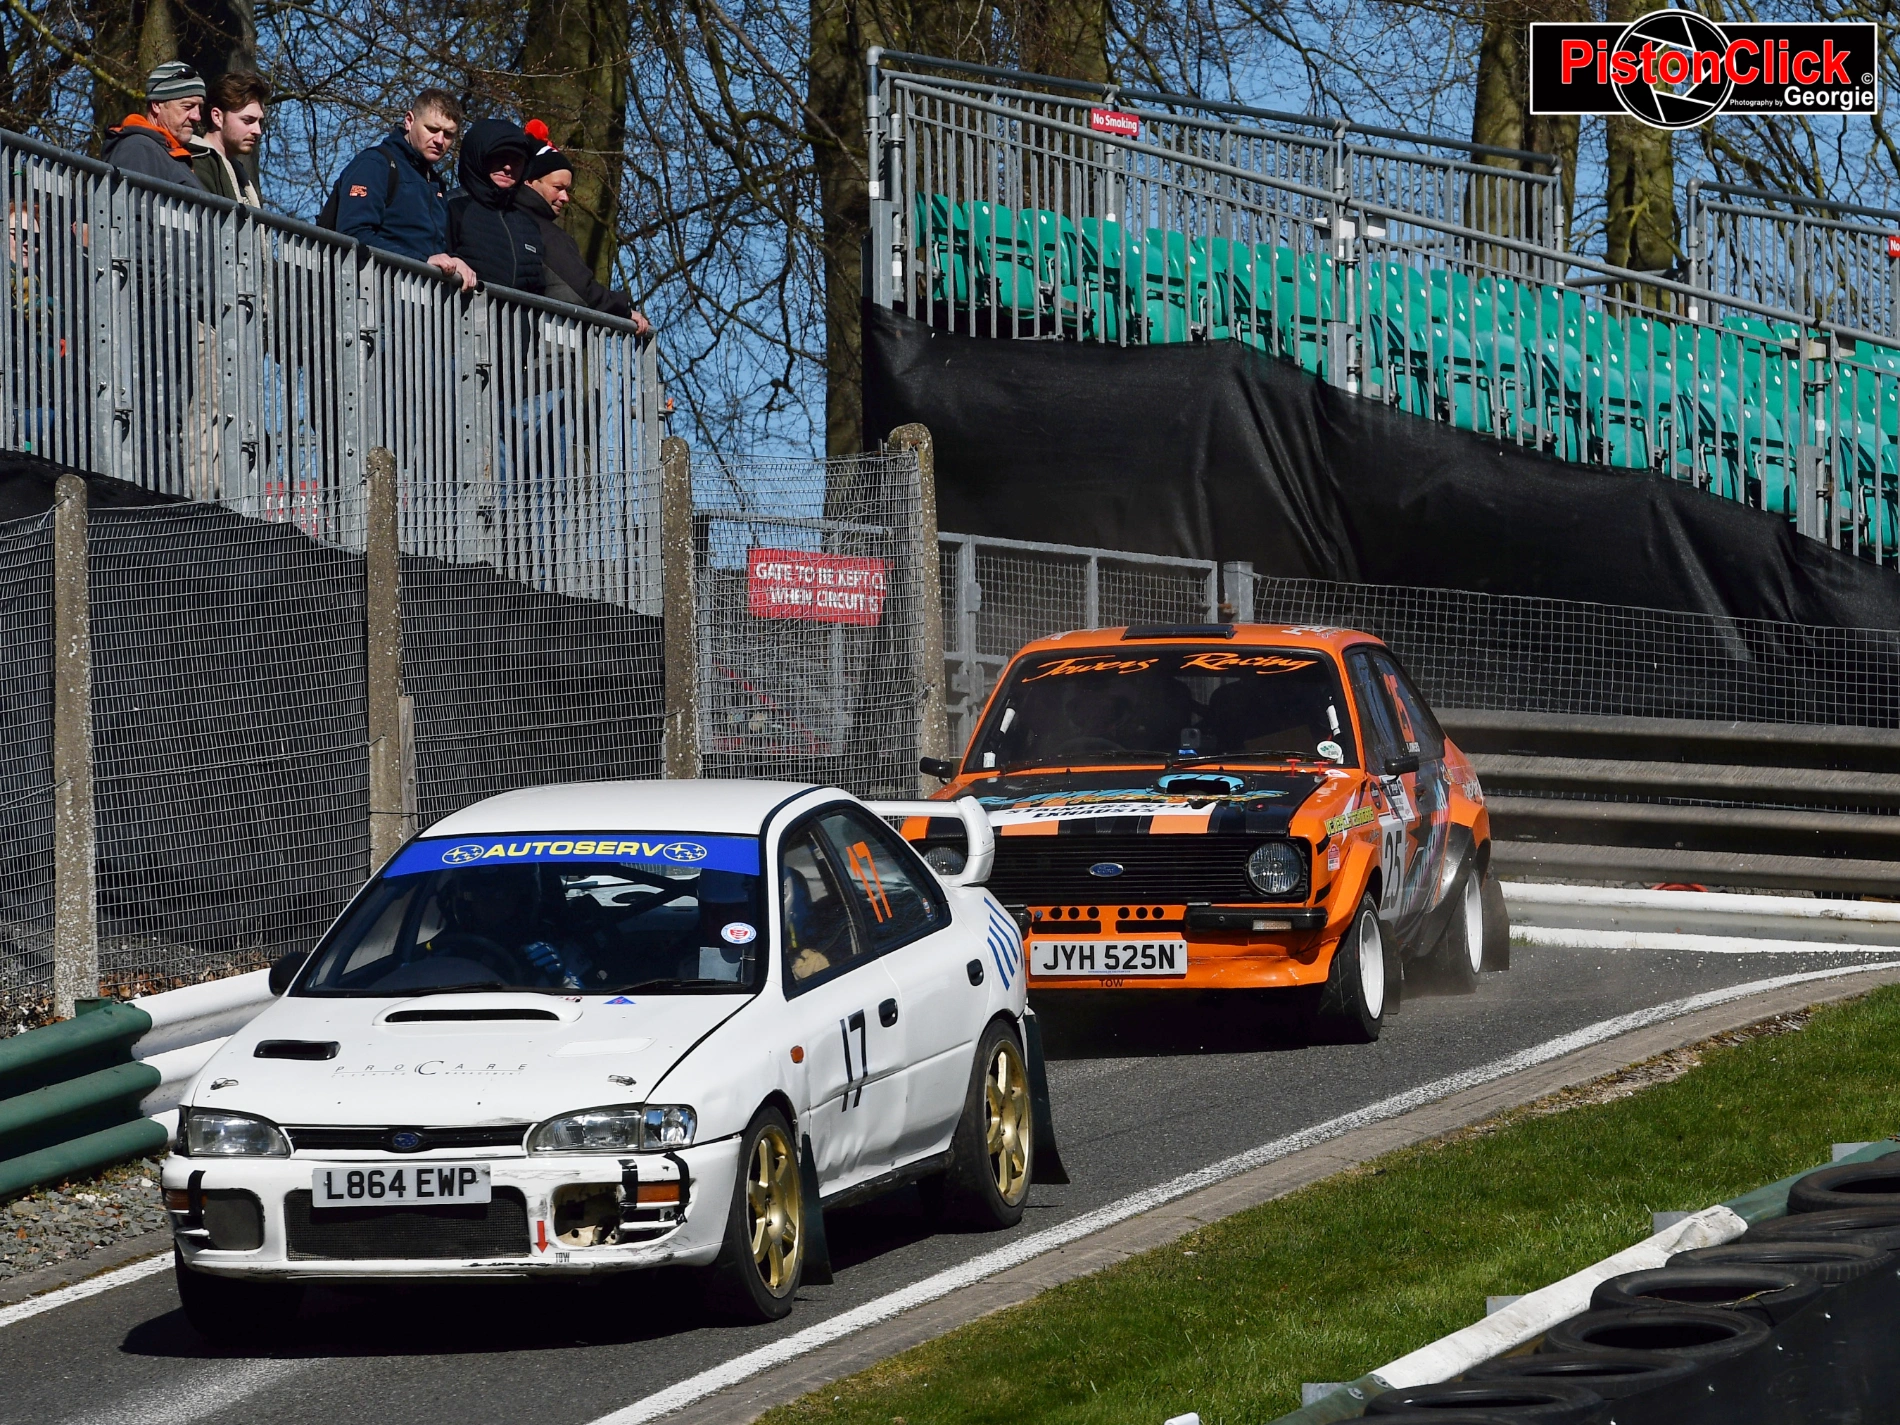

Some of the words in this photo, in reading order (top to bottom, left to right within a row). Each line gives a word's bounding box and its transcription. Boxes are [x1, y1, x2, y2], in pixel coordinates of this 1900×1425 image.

[1093, 113, 1104, 125] No
[1105, 115, 1137, 133] Smoking
[756, 563, 792, 581] GATE
[795, 565, 815, 584] TO
[818, 567, 835, 585] BE
[838, 569, 870, 588] KEPT
[769, 587, 813, 607] WHEN
[816, 590, 865, 612] CIRCUIT
[1180, 652, 1318, 675] Racing
[481, 841, 665, 859] AUTOSERV
[845, 841, 893, 923] 17
[1380, 830, 1402, 911] 25
[1042, 944, 1095, 971] JYH
[1104, 944, 1175, 971] 525N
[1099, 979, 1124, 988] TOW
[839, 1008, 869, 1113] 17
[326, 1169, 406, 1200] L864
[416, 1167, 477, 1198] EWP
[555, 1252, 570, 1263] TOW
